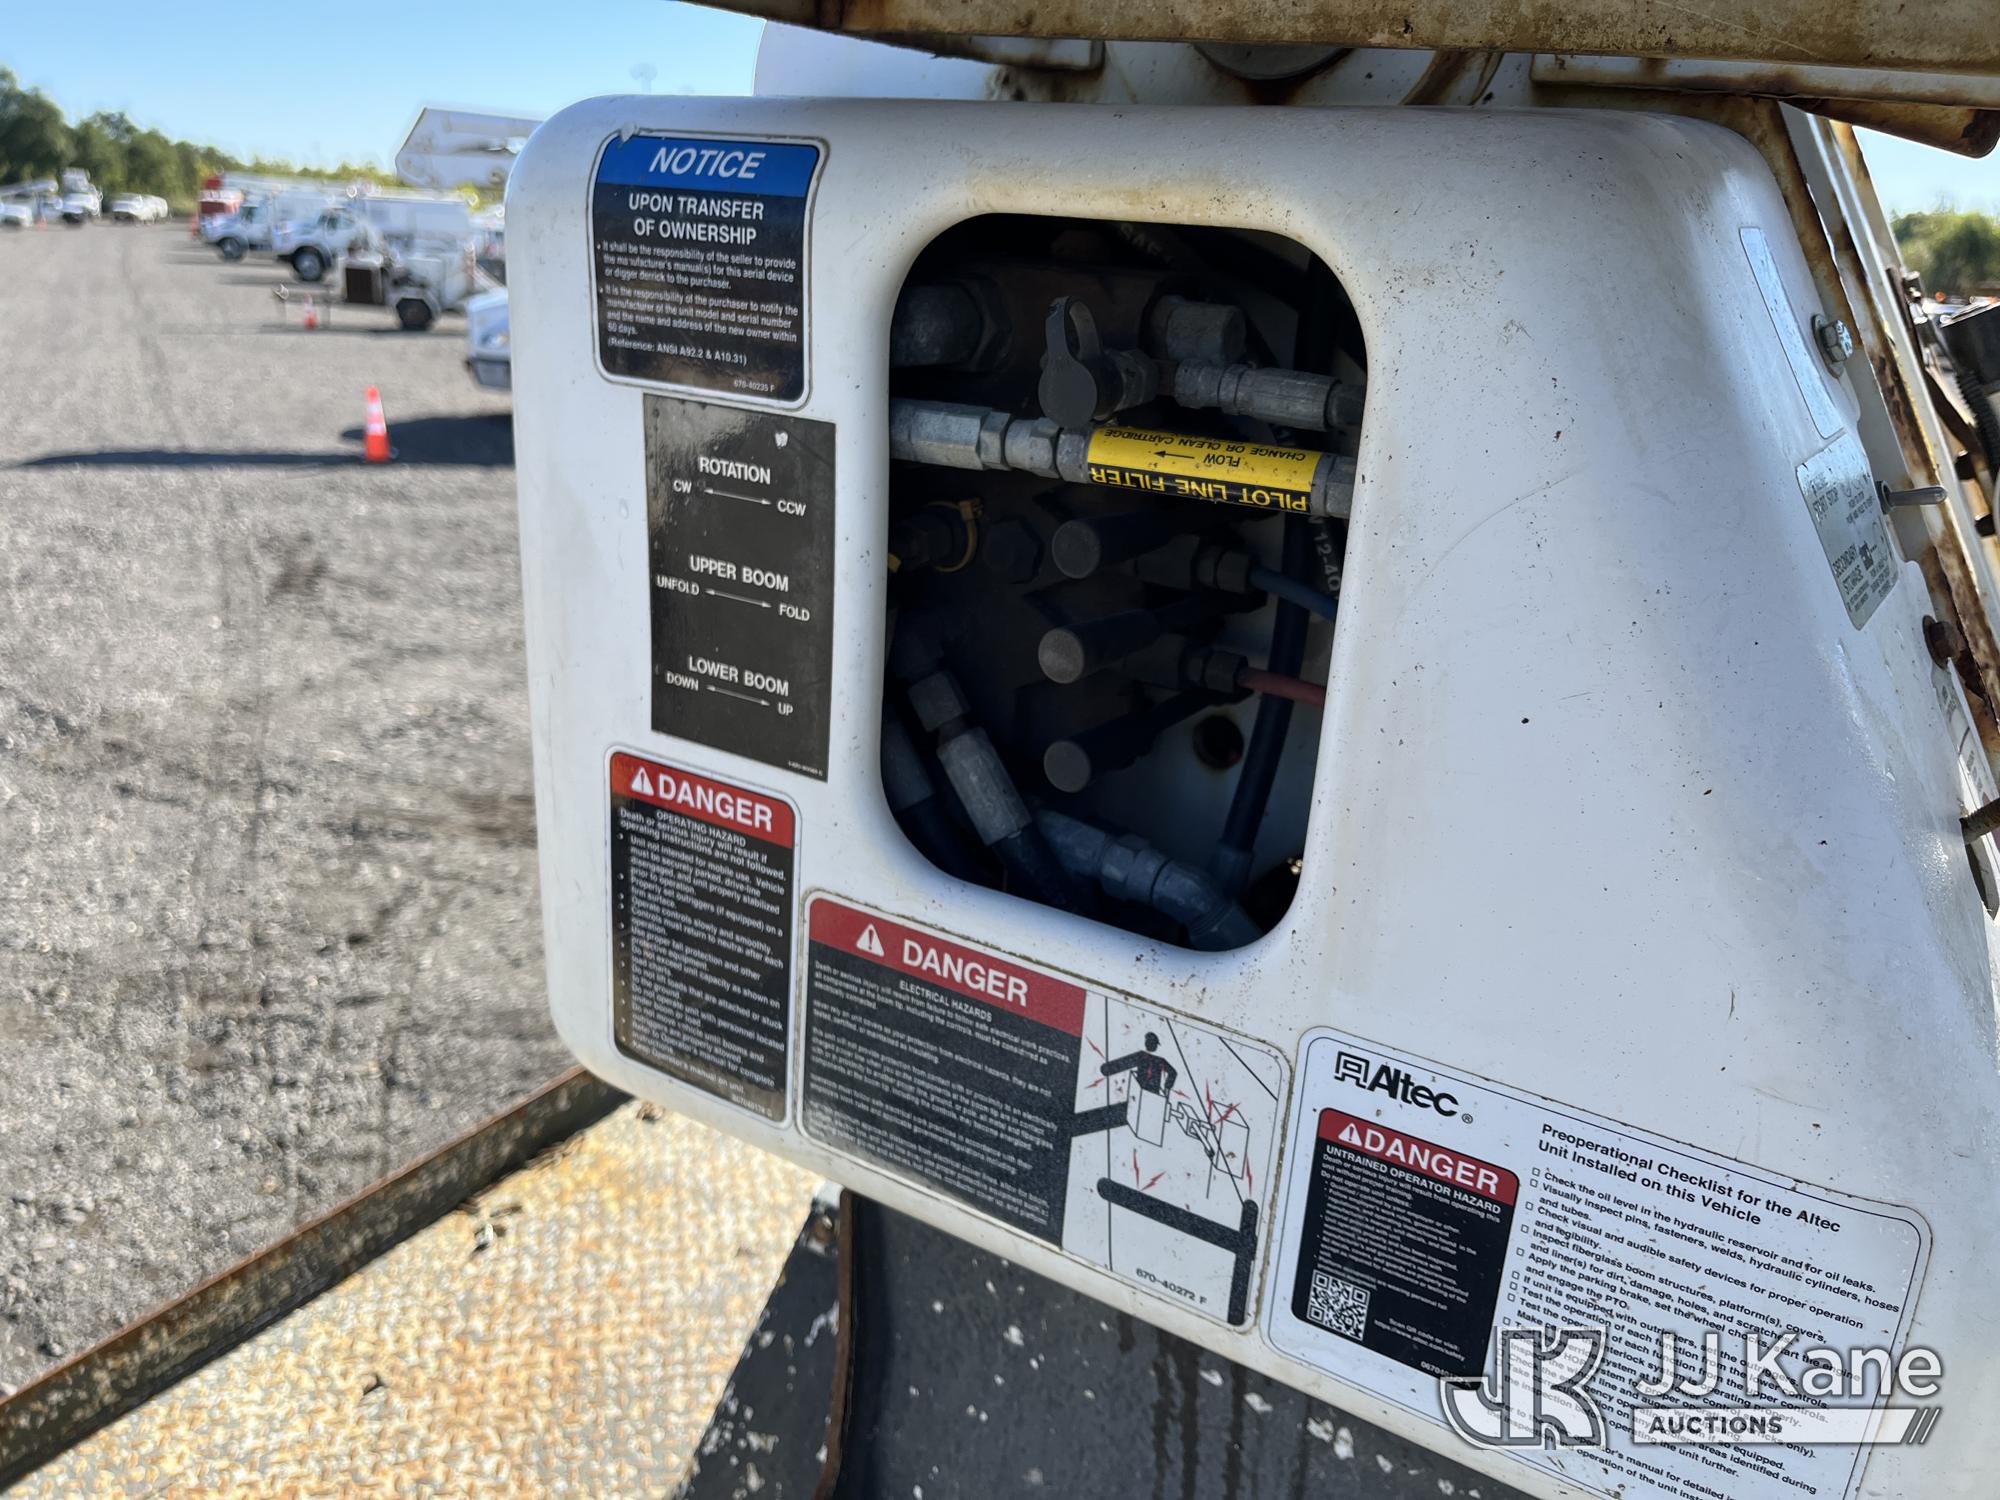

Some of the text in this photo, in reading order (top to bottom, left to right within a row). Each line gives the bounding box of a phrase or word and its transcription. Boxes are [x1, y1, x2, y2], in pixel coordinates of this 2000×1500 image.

[650, 147, 766, 179] NOTICE
[628, 193, 764, 220] UPON TRANSFER
[634, 218, 756, 245] OF OWNERSHIP
[609, 240, 626, 253] shall
[628, 242, 637, 254] be
[639, 243, 651, 255] the
[653, 246, 704, 263] responsibility
[706, 250, 714, 261] of
[715, 251, 729, 262] the
[731, 253, 752, 265] seller
[754, 255, 762, 266] to
[764, 257, 795, 270] provide
[1104, 429, 1306, 461] CHANGE OR CLEAN CARTRIDGE
[1203, 453, 1240, 467] FLOW
[699, 456, 771, 485] ROTATION
[1091, 467, 1306, 512] PILOT LINE FILTER
[673, 480, 806, 516] CW CCW
[689, 554, 789, 592] UPPER BOOM
[656, 575, 810, 622] UNFOLD FOLD
[666, 672, 794, 716] DOWN UP
[688, 655, 789, 696] LOWER BOOM
[659, 773, 772, 832] DANGER
[620, 808, 767, 862] Death or serious injury will result if
[620, 819, 786, 880] operating instructions are not followed.
[656, 810, 745, 846] OPERATING HAZARD
[903, 939, 1028, 1006] DANGER
[900, 980, 992, 1022] ELECTRICAL HAZARDS
[1367, 1064, 1458, 1117] Altec
[1326, 1144, 1501, 1215] UNTRAINED OPERATOR HAZARD
[1365, 1129, 1499, 1195] DANGER
[1537, 1139, 1761, 1225] Unit Installed on this Vehicle
[1541, 1123, 1841, 1233] Preoperational Checklist for the Altec
[1539, 1195, 1592, 1221] and tubes.
[1534, 1218, 1602, 1251] and legibility.
[1541, 1183, 1899, 1314] Visually inspect pins, fasteners, welds, hydraulic cylinders, hoses
[1544, 1172, 1876, 1294] Check the oil level in the hydraulic reservoir and for oil leaks.
[1136, 1268, 1206, 1304] 670-40272 F
[1525, 1264, 1630, 1310] and engage the PTO.
[1530, 1242, 1549, 1256] and
[1551, 1250, 1587, 1269] liner(s)
[1589, 1263, 1604, 1276] for
[1629, 1278, 1674, 1302] damage,
[1677, 1295, 1710, 1314] holes,
[1712, 1308, 1733, 1323] and
[1532, 1229, 1827, 1344] Inspect fiberglass boom structures, platform(s), covers,
[1536, 1206, 1863, 1331] Check visual and audible safety devices for proper operation
[1528, 1253, 1557, 1271] Apply
[1559, 1264, 1576, 1278] the
[1578, 1271, 1617, 1293] parking
[1619, 1286, 1651, 1305] brake,
[1654, 1299, 1671, 1313] set
[1673, 1306, 1691, 1320] the
[1694, 1313, 1725, 1332] wheel
[1523, 1276, 1531, 1285] If
[1532, 1279, 1551, 1293] unit
[1554, 1287, 1563, 1297] is
[1615, 1310, 1637, 1325] with
[1719, 1349, 1737, 1362] the
[1679, 1446, 1700, 1460] unit
[1702, 1455, 1739, 1477] further.
[1730, 1453, 1780, 1480] identified
[1781, 1476, 1817, 1495] during
